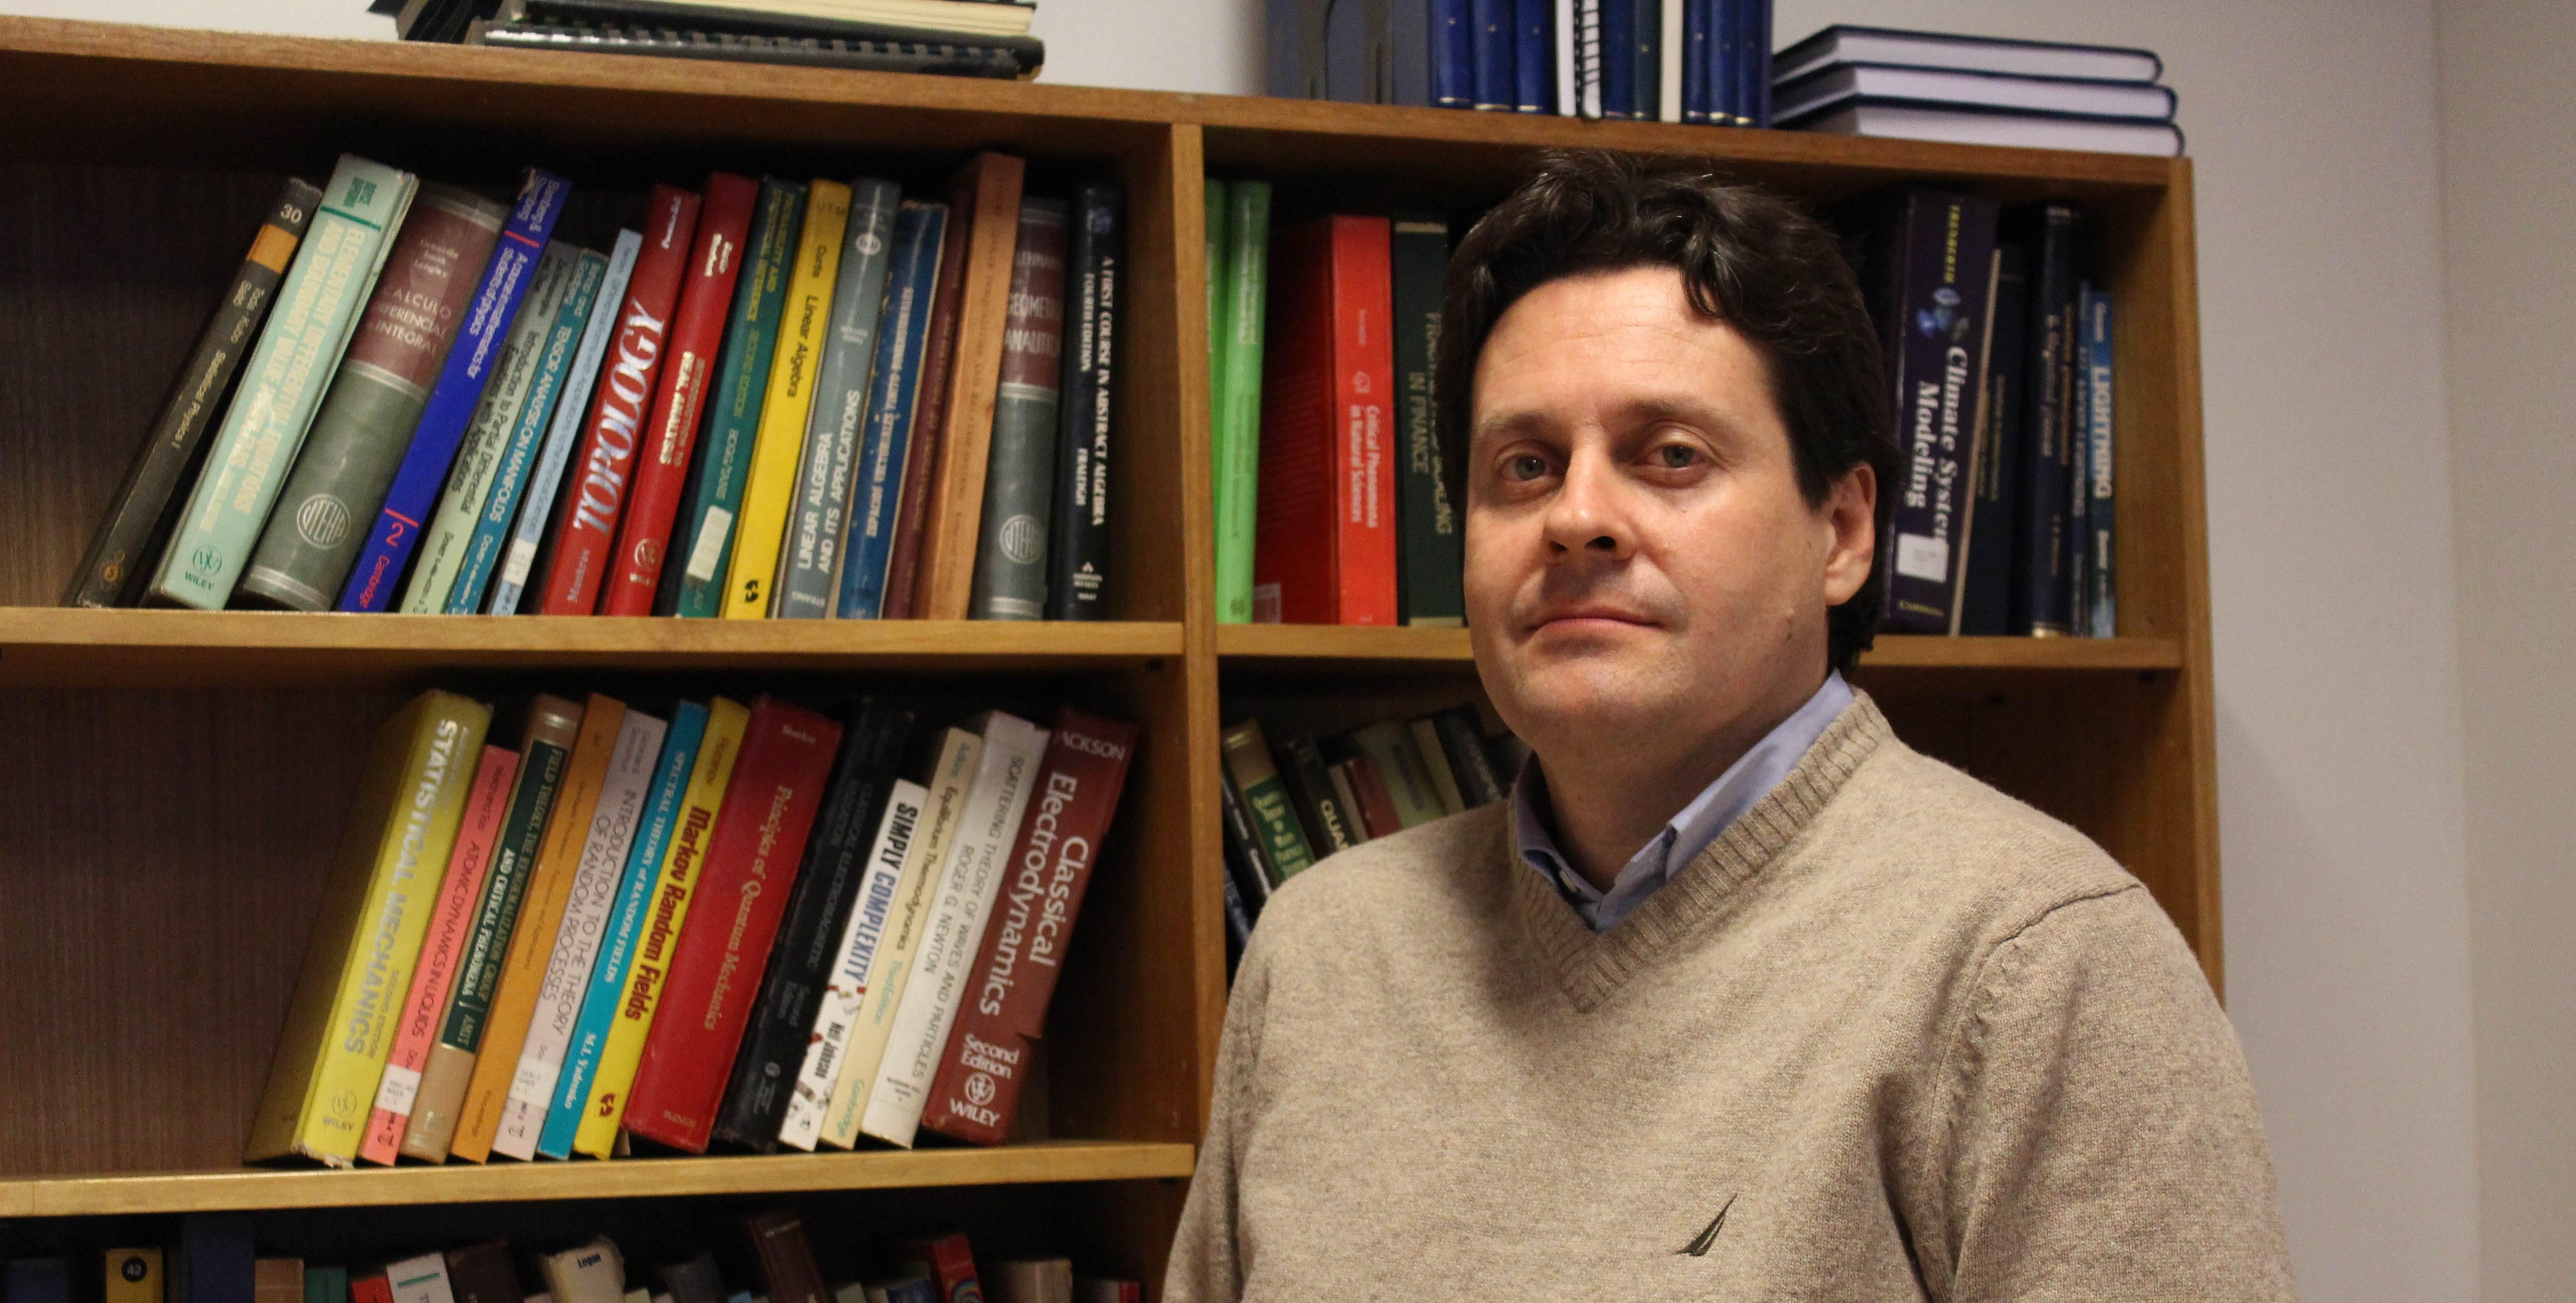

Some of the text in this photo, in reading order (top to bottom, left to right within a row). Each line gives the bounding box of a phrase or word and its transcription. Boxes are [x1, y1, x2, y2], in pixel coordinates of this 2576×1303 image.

[280, 204, 303, 225] 30
[316, 219, 345, 255] AND
[281, 252, 331, 336] BOUNDARY
[310, 227, 367, 327] ELEMENTARY
[488, 245, 517, 290] students
[501, 260, 524, 295] course
[765, 264, 780, 293] AND
[466, 294, 495, 338] physics
[472, 299, 509, 365] mathematics
[544, 323, 572, 373] TENSOR
[783, 244, 828, 398] Curtis Linear Algebra
[1079, 272, 1095, 373] FOURTH EDITION
[261, 333, 296, 383] VALUE
[266, 322, 327, 427] DIFFERENTIAL
[465, 361, 483, 380] for
[1090, 255, 1116, 526] A FIRST COURSE IN ABSTRACT ALGEBRA
[172, 349, 227, 444] Statistical Physics
[450, 344, 519, 495] Equations with Applications
[459, 329, 540, 515] Introduction to Partial Differential
[524, 370, 555, 426] ANALYSIS
[570, 294, 671, 537] TOPOLOGY
[656, 349, 697, 465] REAL ANALYSIS
[1407, 370, 1430, 475] IN FINANCE
[1938, 344, 1969, 452] Climate
[516, 423, 535, 448] ON
[1350, 404, 1364, 523] in Natural Sciences
[1904, 380, 1942, 509] Modeling
[2093, 365, 2111, 499] LIGHTNING
[230, 426, 284, 515] EQUATIONS
[488, 446, 527, 523] MANIFOLDS
[796, 430, 833, 570] LINEAR ALGEBRA
[815, 388, 862, 573] AND ITS APPLICATIONS
[1074, 447, 1088, 507] FRALEIGH
[1365, 405, 1379, 529] Critical Phenomena
[385, 523, 409, 547] 2
[185, 570, 214, 591] WILEY
[359, 555, 391, 609] Cambridge
[542, 747, 564, 783] FIELD
[1054, 731, 1127, 762] ACKSON
[391, 716, 459, 890] STATISTICAL
[656, 750, 687, 816] SPECTRAL
[520, 831, 538, 856] THE
[639, 814, 667, 869] THEORY
[923, 783, 960, 851] Equilibrium
[454, 840, 482, 895] ATOMIC
[804, 781, 875, 973] CLASSICAL ELECTROMAGNETIC
[841, 800, 920, 984] SIMPLY COMPLEXITY
[970, 766, 1077, 1021] Electrodynamics
[1027, 832, 1091, 968] Classical
[432, 893, 467, 969] DYNAMICS
[460, 847, 518, 997] AND CRITICAL PHENOMENA
[486, 855, 531, 962] RENORMALIZATION
[541, 814, 613, 1003] OF RANDOM PROCESSES
[550, 786, 638, 1037] INTRODUCTION TO THE THEORY
[617, 880, 645, 940] RANDOM
[623, 804, 713, 1023] Markov Random Fields
[702, 783, 794, 1033] Principles of Quantum Mechanics
[891, 849, 939, 954] Thermodynamics
[909, 753, 1026, 1081] SCATTERING THEORY OF WAVES AND PARTICLES
[922, 843, 976, 976] ROGER G. NEWTON
[341, 888, 410, 1058] MECHANICS
[427, 967, 444, 985] IN
[475, 962, 498, 1003] GROUP
[603, 938, 628, 985] FIELDS
[883, 959, 904, 988] Third
[410, 983, 439, 1038] LIQUIDS
[455, 1014, 478, 1047] AMIT
[776, 980, 800, 1021] Edition
[787, 983, 812, 1029] Second
[871, 985, 895, 1026] Edition
[813, 1021, 846, 1080] Neil Johnson
[960, 1048, 1012, 1080] Edition
[963, 1032, 1020, 1068] Second
[561, 1056, 589, 1111] Yadrenko
[832, 1075, 867, 1141] Cambridge
[949, 1096, 1001, 1128] WILEY
[322, 1114, 354, 1132] WILEY
